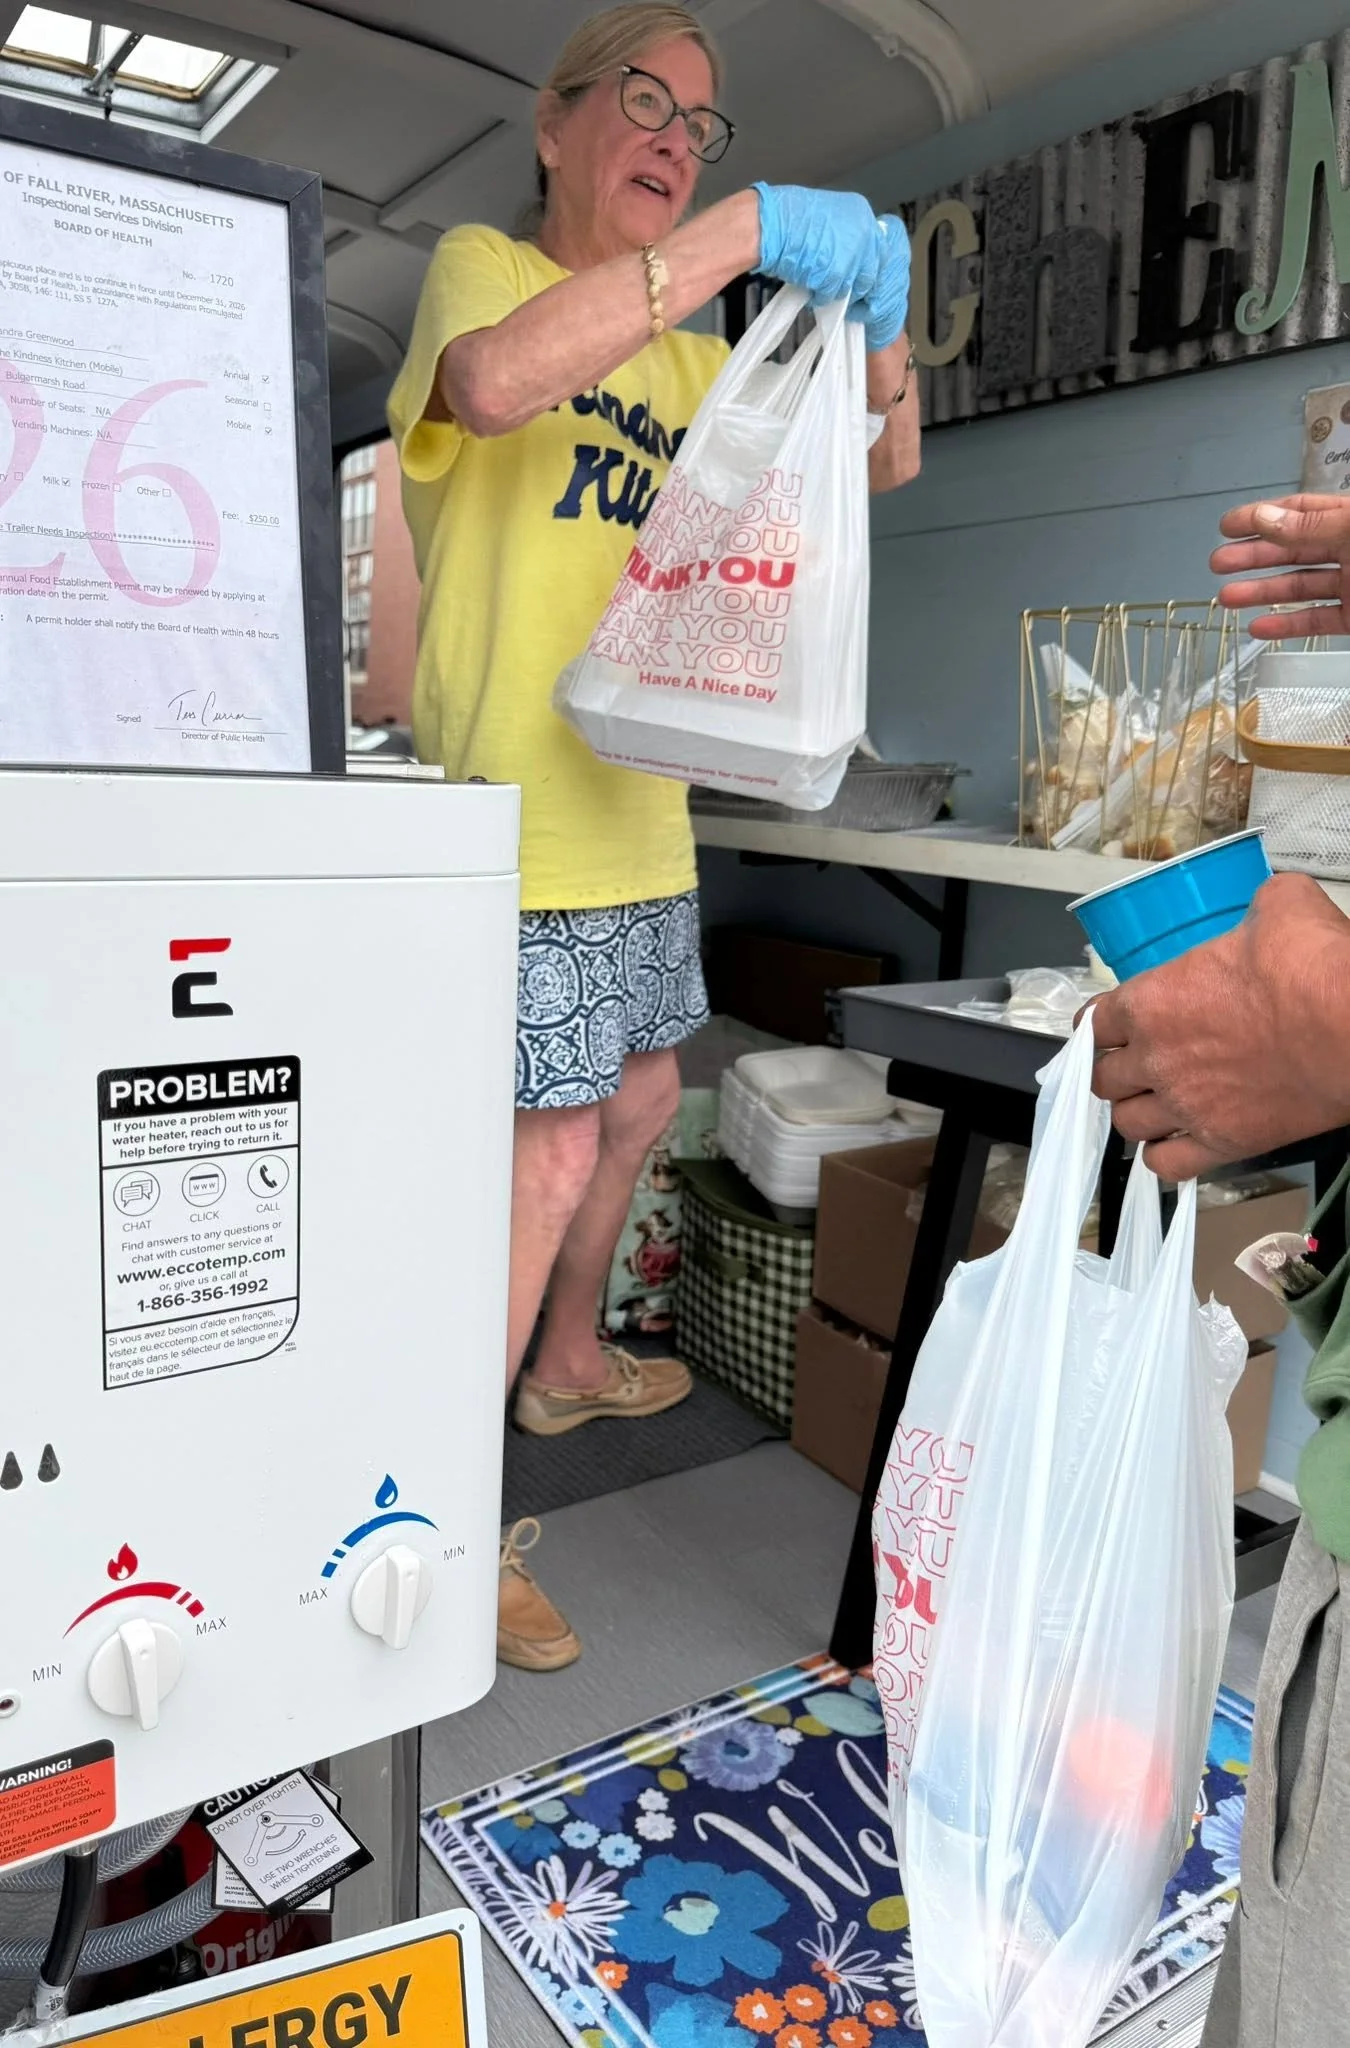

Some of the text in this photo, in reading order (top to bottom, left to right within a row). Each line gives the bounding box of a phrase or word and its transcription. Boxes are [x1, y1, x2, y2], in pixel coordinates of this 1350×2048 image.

[4, 171, 234, 229] OF FALL RIVER, MASSACHUSETTS
[22, 192, 183, 234] Inspectional Services Division
[54, 219, 152, 247] BOARD OF HEALTH
[210, 274, 234, 287] 1720
[26, 330, 74, 347] Greenwood
[13, 350, 52, 364] Kindness
[54, 356, 87, 370] Kitchen
[89, 360, 124, 378] (Mobile)
[62, 379, 86, 390] Road
[223, 370, 250, 382] Annual
[10, 395, 112, 416] Number of Seats: N/A
[224, 396, 258, 408] Seasonal
[12, 419, 112, 440] Vending Machines: N/A
[226, 420, 252, 431] Mobile
[42, 475, 60, 486] Milk
[82, 480, 110, 490] Frozen
[136, 486, 160, 496] Other
[222, 510, 240, 520] Fee:
[5, 522, 34, 532] Trailer
[37, 526, 64, 536] Needs
[697, 556, 796, 589] YOU
[28, 588, 46, 597] date
[30, 574, 256, 602] Food Establishment Permit may renewed applying
[35, 614, 280, 640] permit holder shall notify Board Health within 48 hours
[680, 614, 787, 649] YOU
[676, 642, 782, 679] YOU
[639, 671, 778, 704] Have A Nice Day
[116, 714, 142, 724] Signed
[181, 732, 266, 743] Director Public Health
[109, 1067, 291, 1108] PROBLEM?
[113, 1107, 288, 1133] If you have problem with your
[112, 1118, 289, 1145] water heater, reach out to us for
[119, 1132, 283, 1159] help before trying to return it.
[190, 1211, 220, 1223] CLICK
[256, 1202, 280, 1213] CALL
[122, 1220, 152, 1232] CHAT
[122, 1221, 282, 1251] Find answers any questions or
[132, 1235, 273, 1264] chat with customer service at
[117, 1247, 286, 1284] www.eccotemp.com
[160, 1269, 248, 1292] or, give us call at
[136, 1279, 268, 1312] 1-866-356-1992
[120, 1335, 142, 1344] vous
[144, 1330, 166, 1340] avez
[168, 1323, 198, 1335] besoin
[242, 1309, 276, 1323] français,
[109, 1319, 283, 1358] visitez eu.eccotemp.com sélectionnez
[109, 1334, 266, 1371] français dans sélecteur langue
[109, 1363, 182, 1383] haut page.
[443, 1545, 466, 1562] MIN
[298, 1588, 328, 1606] MAX
[196, 1616, 228, 1636] MAX
[32, 1664, 63, 1683] MIN
[32, 1778, 68, 1795] FOLLOW
[212, 1778, 301, 1835] DO NOT OVER TIGHTEN
[259, 1834, 338, 1885] USE TWO WRENCHES
[270, 1874, 294, 1890] WHEN
[294, 1845, 341, 1875] TIGHTENING
